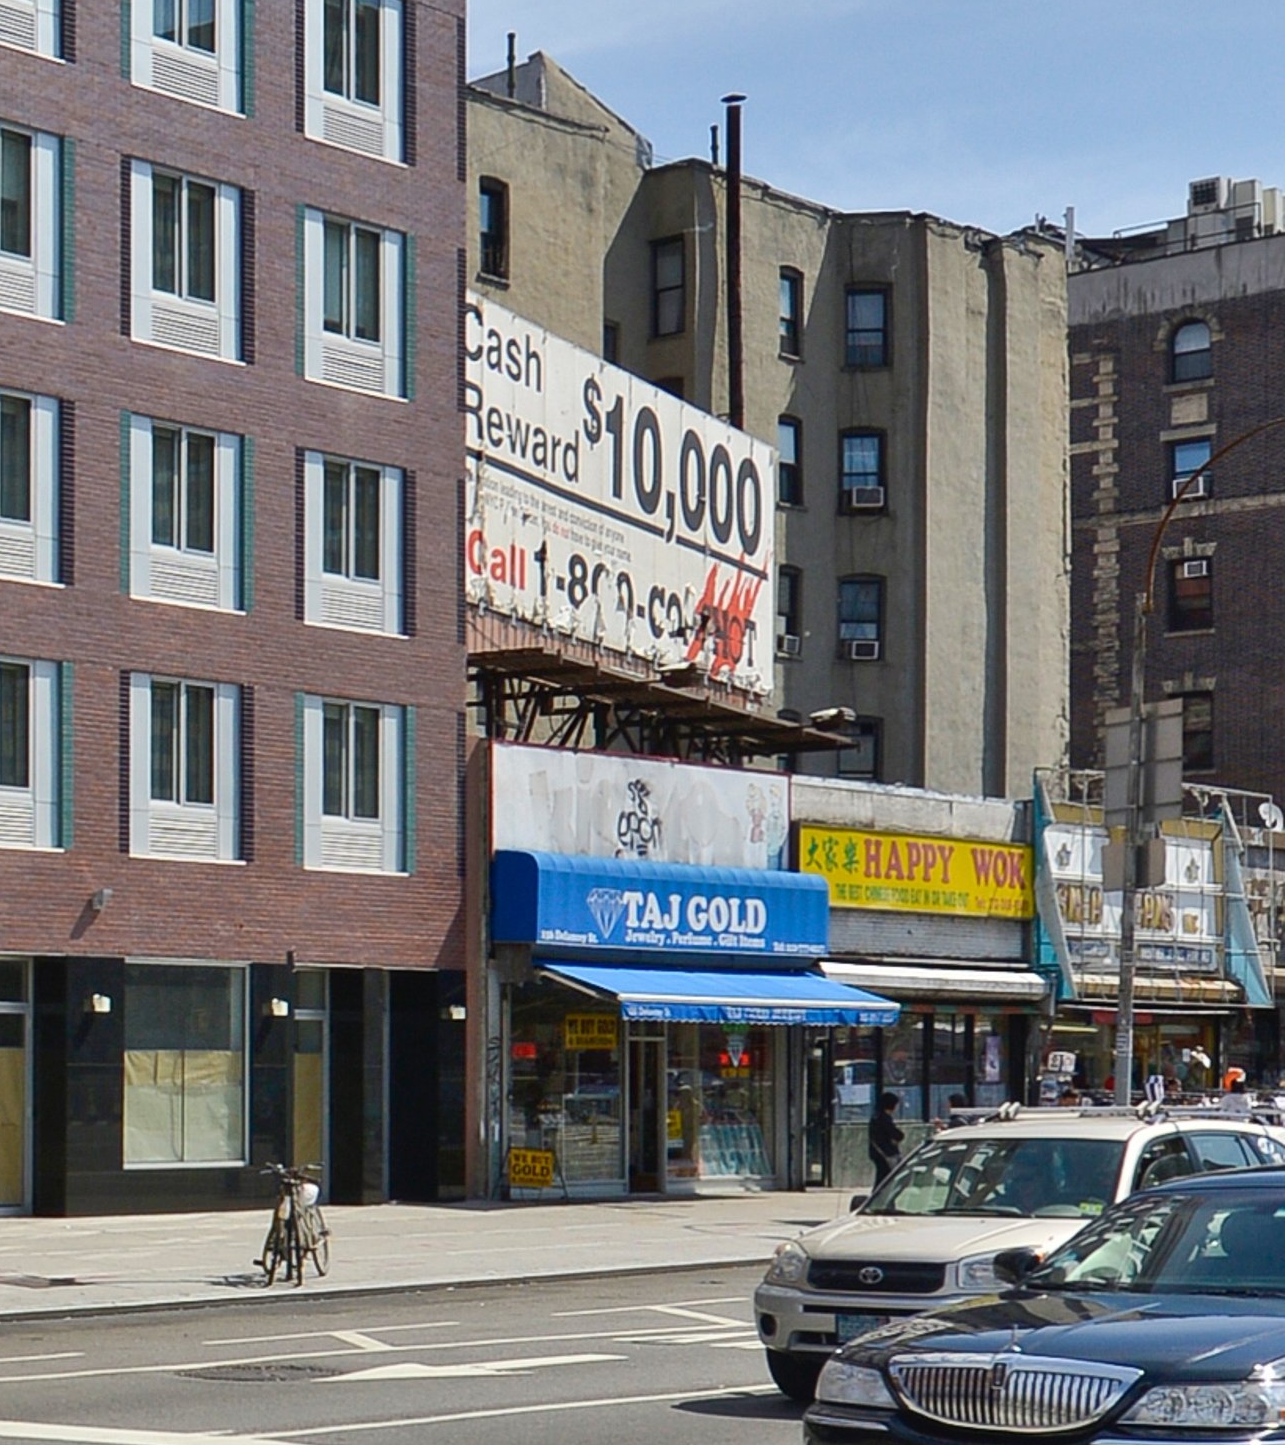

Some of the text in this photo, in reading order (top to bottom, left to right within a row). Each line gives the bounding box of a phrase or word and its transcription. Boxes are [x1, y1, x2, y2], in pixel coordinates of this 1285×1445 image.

[465, 303, 542, 393] Cash
[465, 380, 579, 484] Reward
[582, 372, 762, 556] $10,000
[467, 529, 526, 590] Call
[863, 838, 1027, 891] HAPPY WOK
[621, 891, 768, 934] TAJ GOLD
[625, 929, 666, 947] Jewelry
[672, 931, 713, 946] Perfume
[512, 1163, 551, 1178] GOLD
